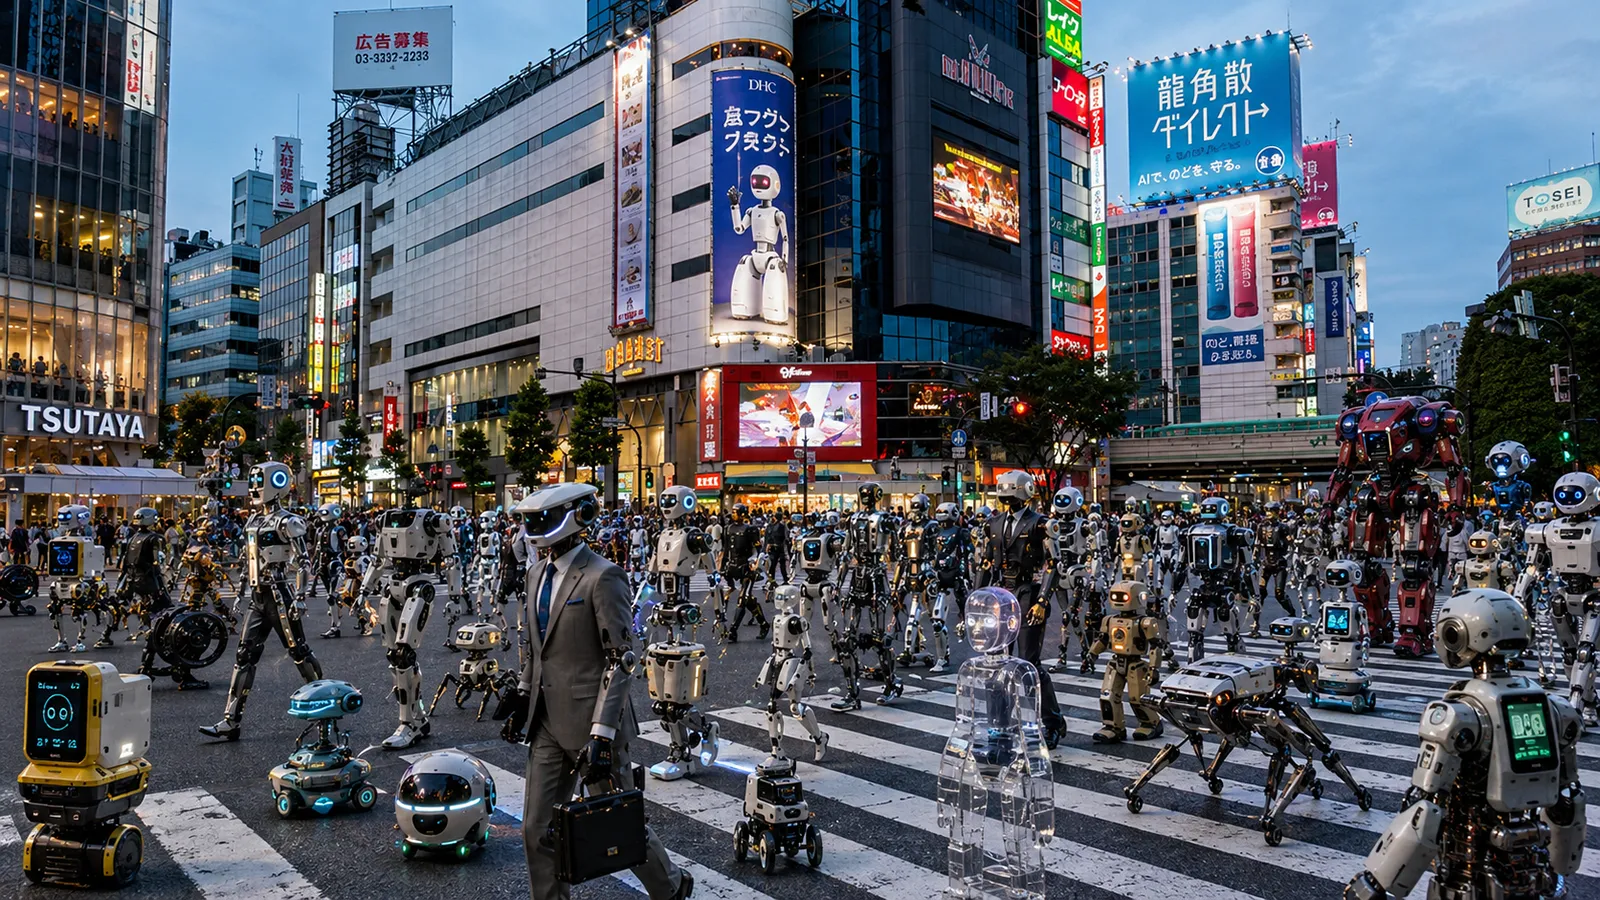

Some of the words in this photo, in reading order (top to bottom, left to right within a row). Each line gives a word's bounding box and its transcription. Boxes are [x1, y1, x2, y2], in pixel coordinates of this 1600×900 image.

[1047, 1, 1080, 36] レイク
[355, 31, 430, 50] 広告募集
[748, 78, 777, 94] DHC
[1157, 58, 1253, 112] 龍角散
[1151, 99, 1270, 149] ダイレクト
[1523, 185, 1582, 208] TOSEI
[20, 404, 145, 439] TSUTAYA
